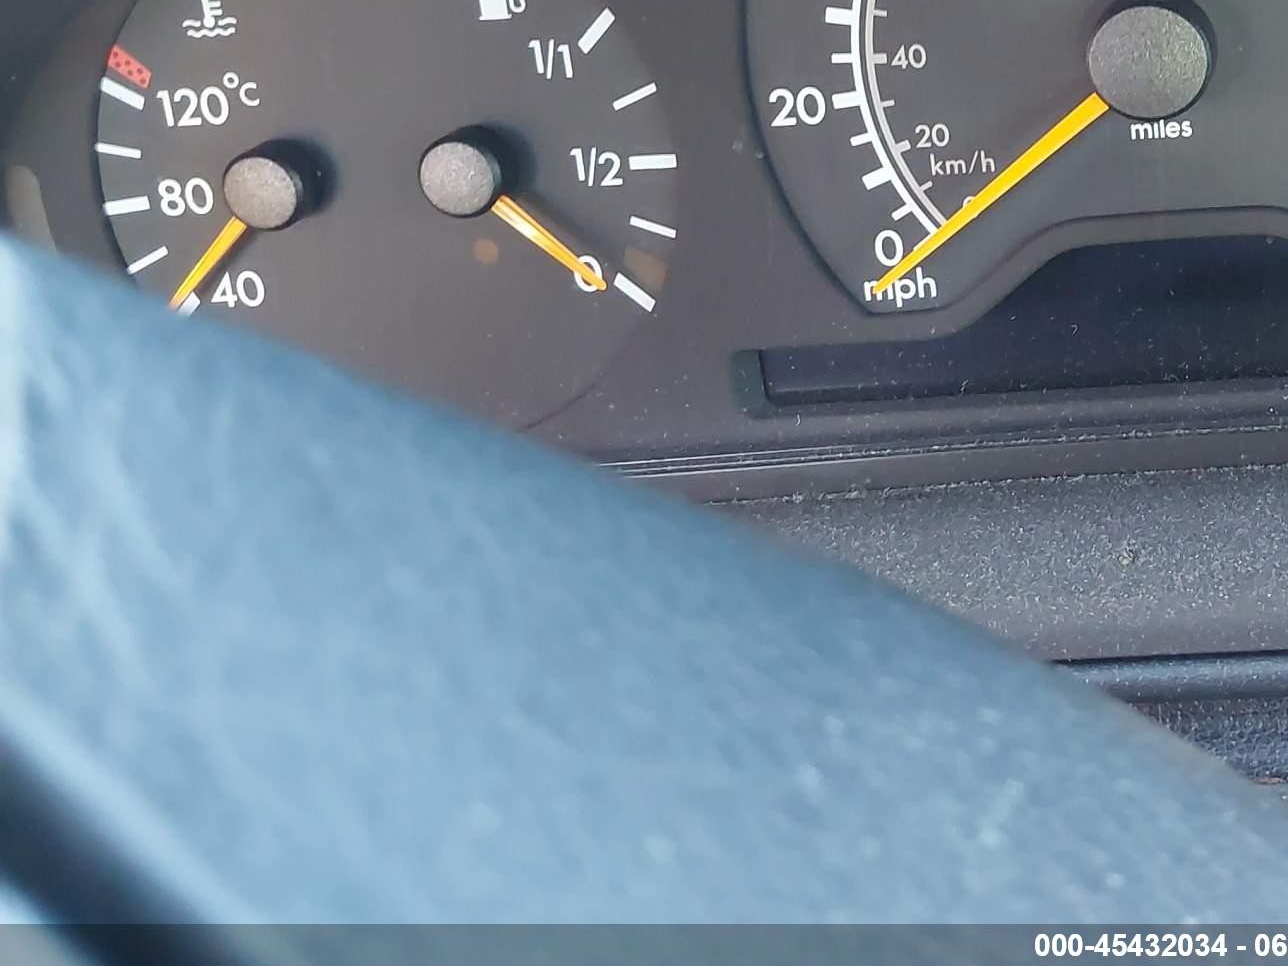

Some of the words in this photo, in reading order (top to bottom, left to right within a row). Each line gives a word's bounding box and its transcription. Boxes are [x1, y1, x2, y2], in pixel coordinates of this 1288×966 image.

[528, 39, 574, 79] 1/1
[891, 45, 927, 70] 40
[769, 86, 825, 127] 20
[915, 124, 950, 149] 20
[1130, 118, 1192, 139] miles
[571, 148, 623, 186] 1/2
[930, 150, 996, 176] km/h
[157, 179, 214, 217] 80
[874, 230, 904, 266] 0
[211, 271, 265, 308] 40
[574, 255, 604, 292] 0
[864, 267, 937, 307] mph
